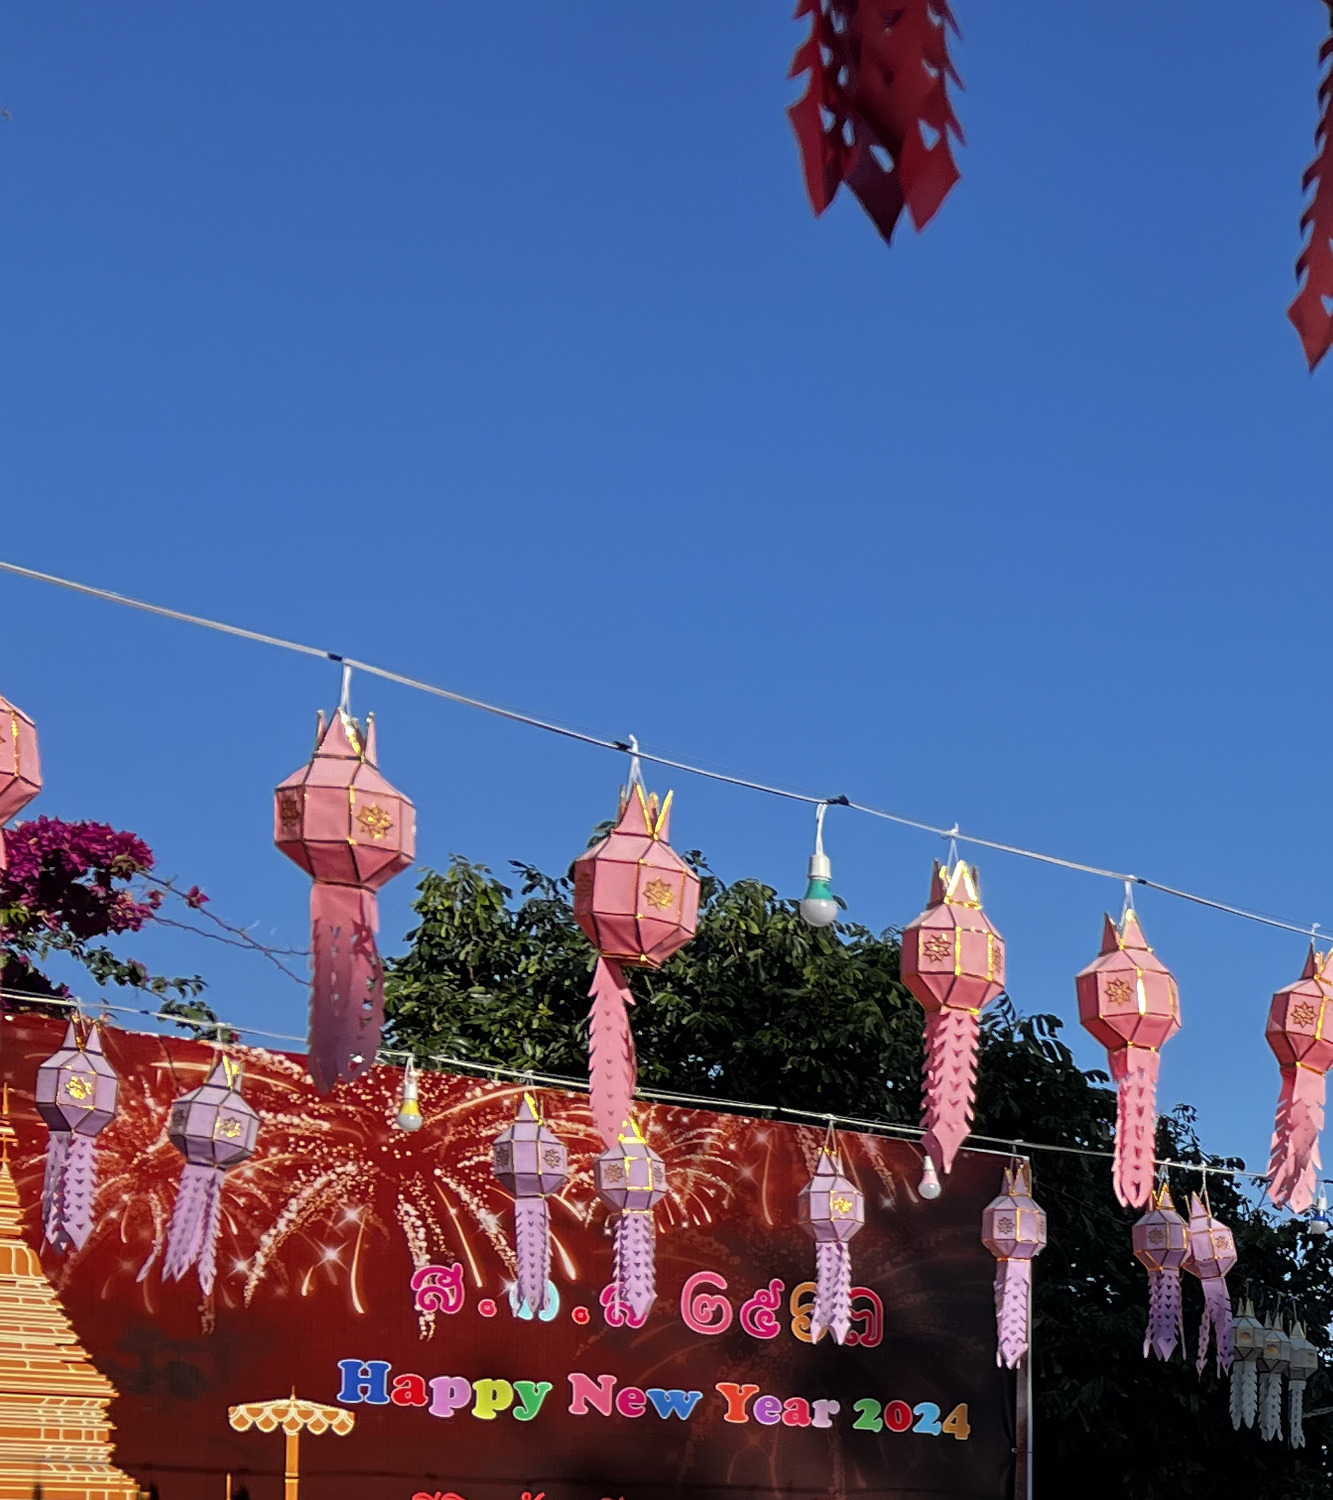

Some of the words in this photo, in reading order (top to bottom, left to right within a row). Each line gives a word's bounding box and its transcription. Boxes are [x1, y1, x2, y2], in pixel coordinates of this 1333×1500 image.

[336, 1358, 552, 1421] Happy
[567, 1373, 703, 1420] New
[714, 1382, 840, 1428] Year
[852, 1398, 971, 1440] 2024
